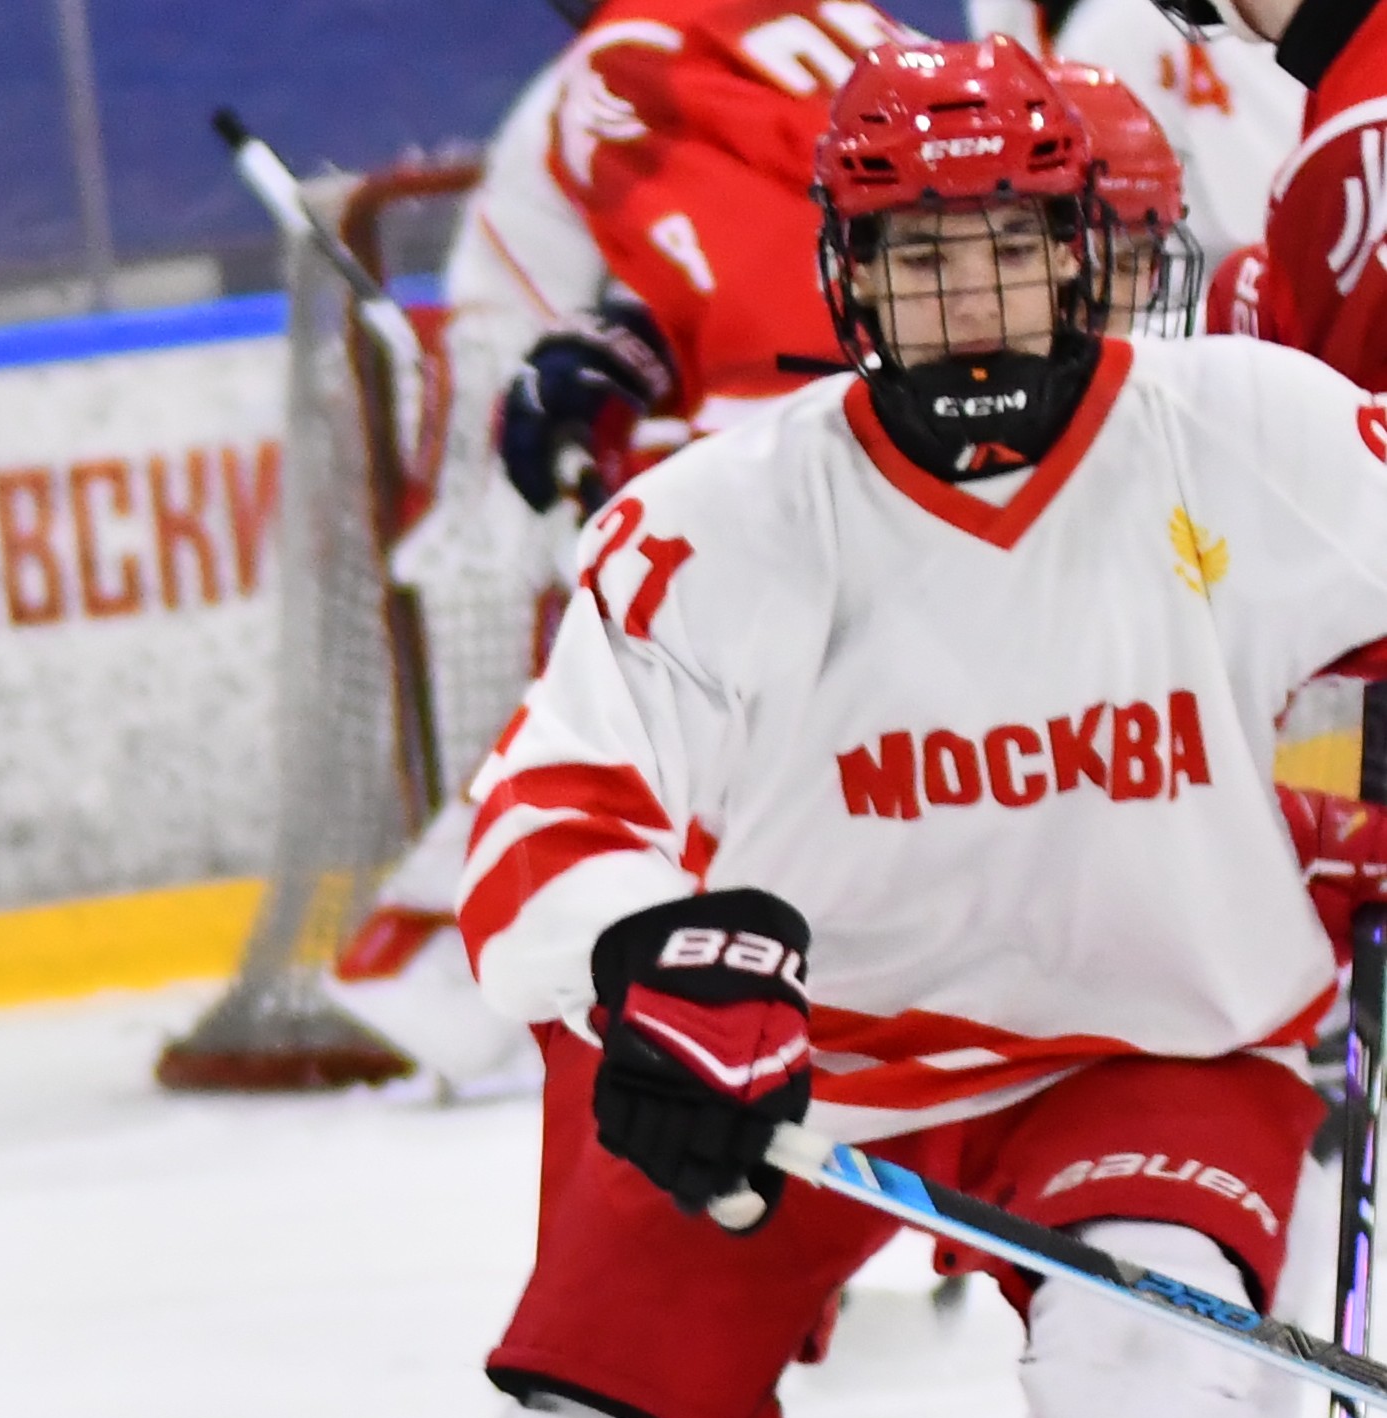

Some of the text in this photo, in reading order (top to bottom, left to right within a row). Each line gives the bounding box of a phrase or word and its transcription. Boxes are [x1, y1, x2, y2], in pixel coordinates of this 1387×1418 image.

[921, 135, 1005, 161] CCM
[933, 388, 1027, 417] CCM
[579, 497, 696, 641] 21
[836, 688, 1212, 821] МОСКВА
[1038, 1152, 1280, 1236] BAUER
